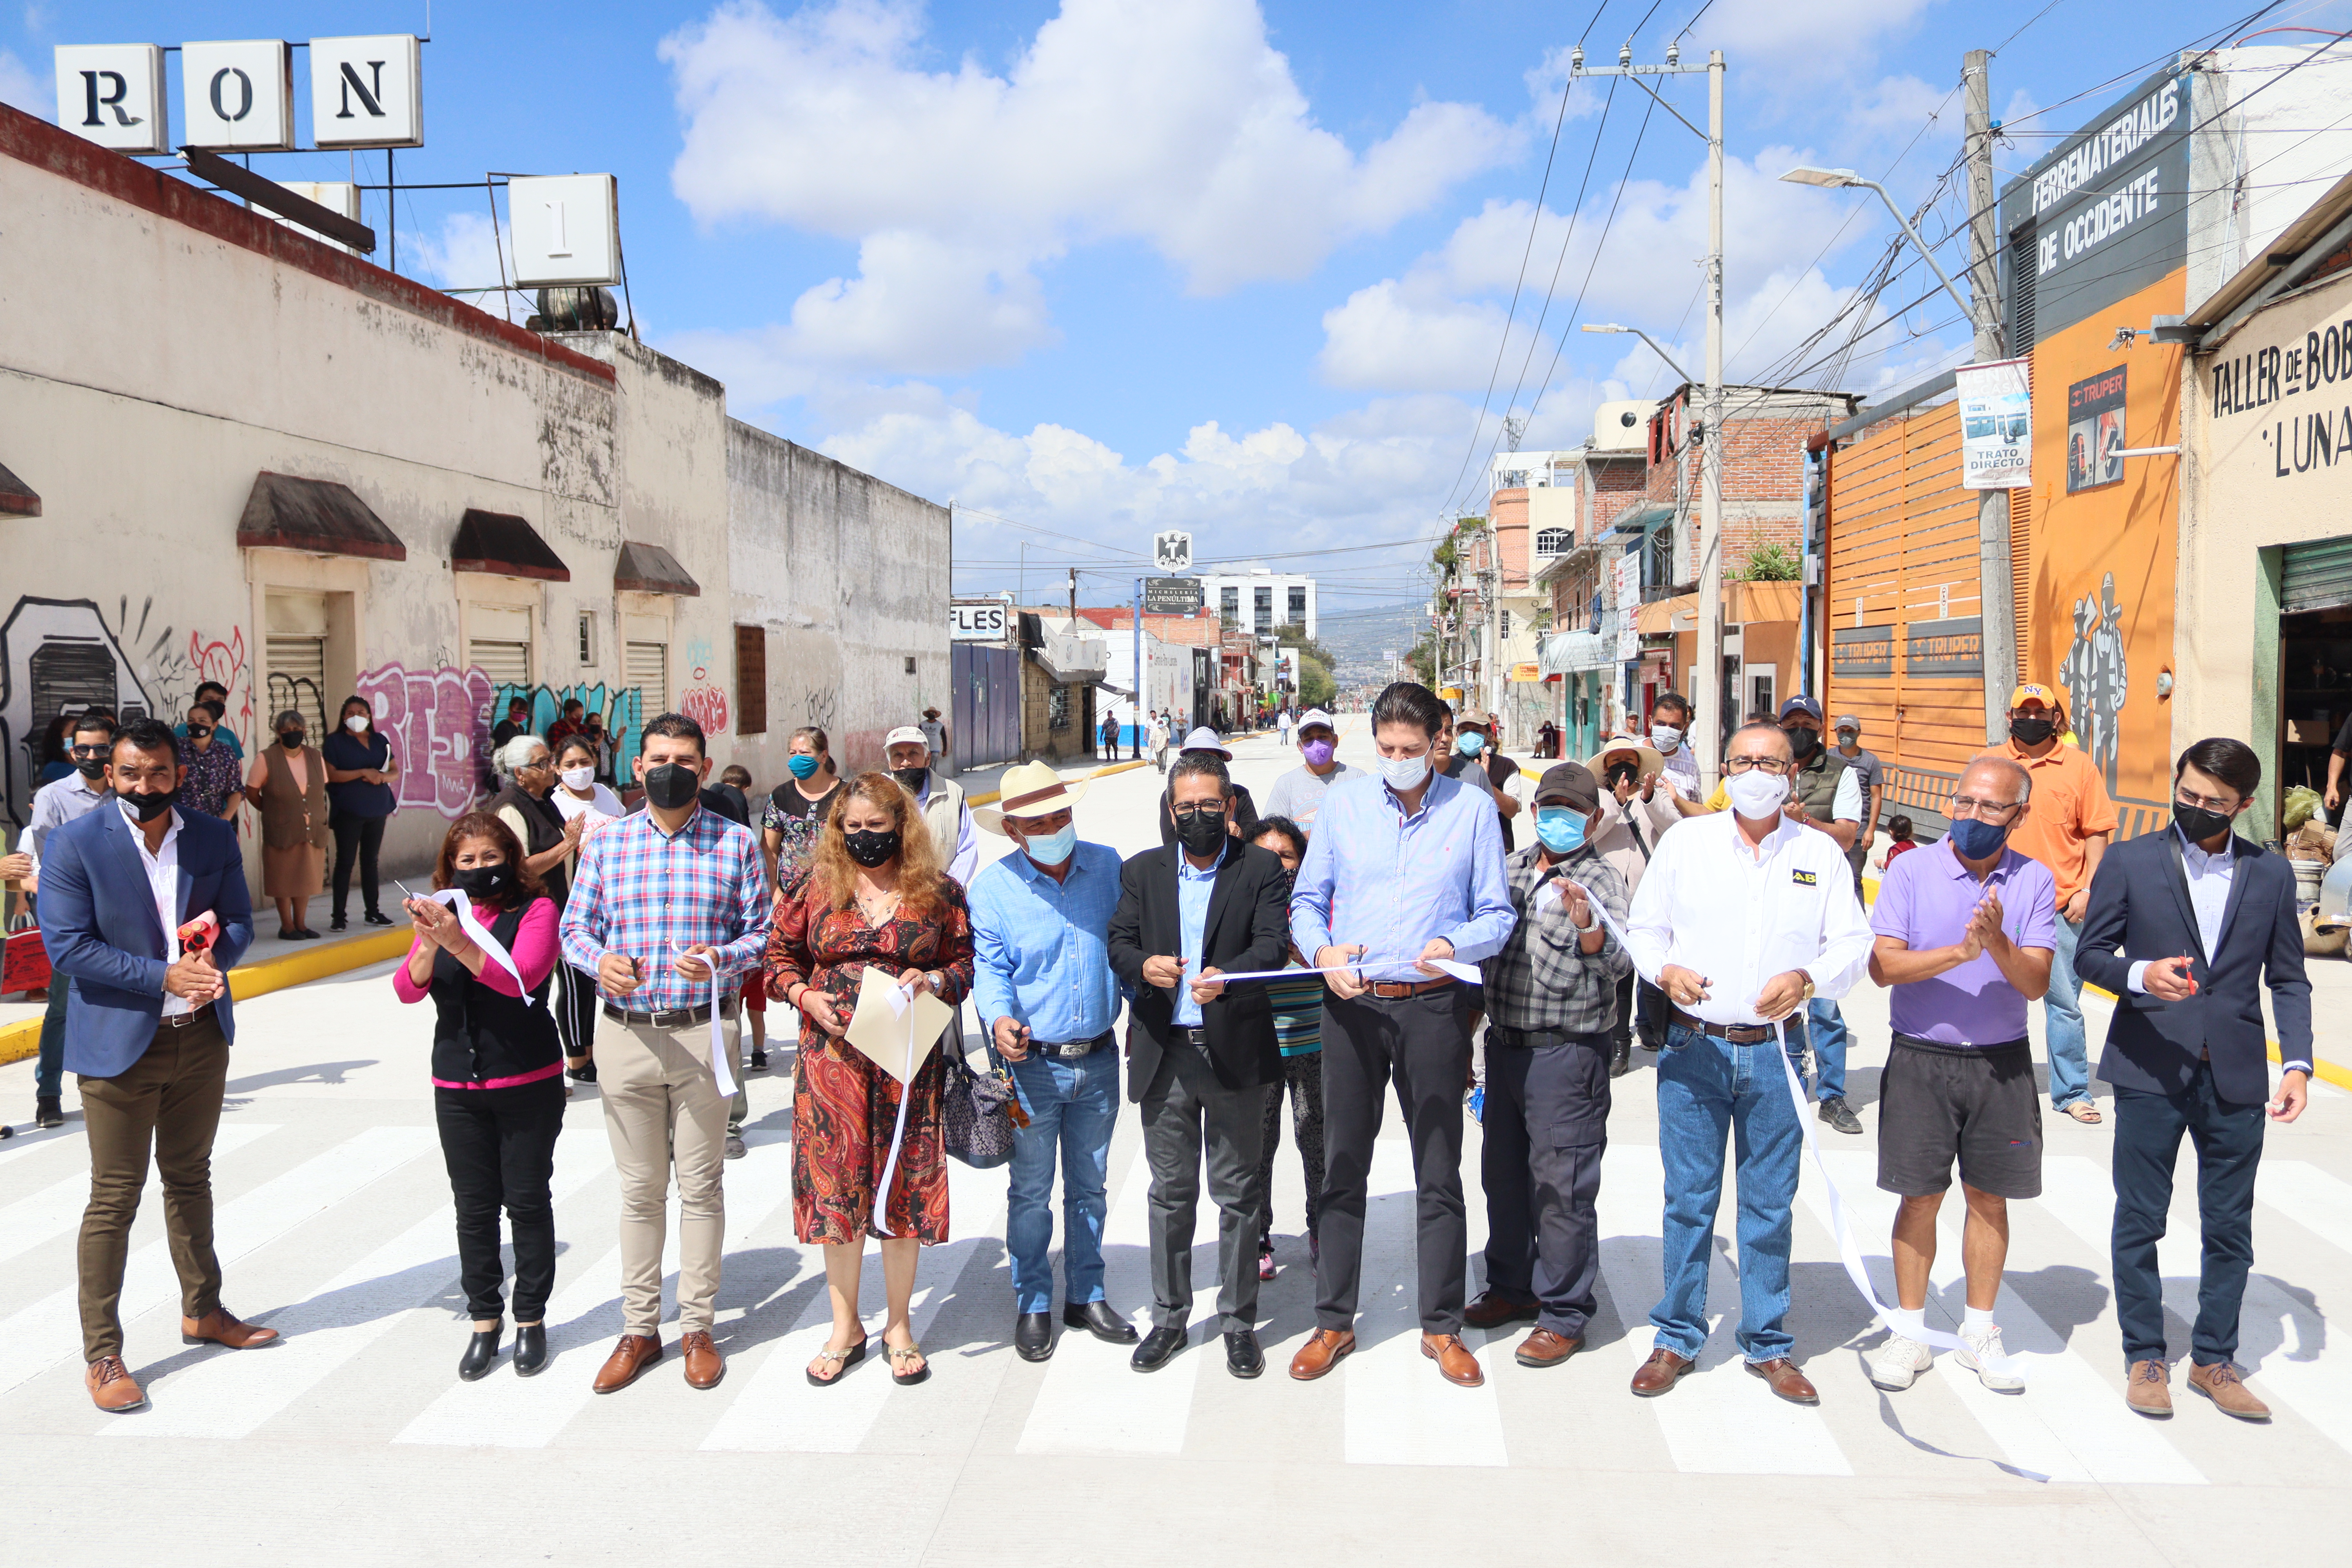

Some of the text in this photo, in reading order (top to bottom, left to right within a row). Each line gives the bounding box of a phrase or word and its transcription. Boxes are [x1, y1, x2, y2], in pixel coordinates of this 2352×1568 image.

[2032, 79, 2178, 216] FERREMATERIALES
[2039, 166, 2159, 276] DE OCCIDENTE
[1960, 365, 2027, 386] VENTA
[2212, 345, 2281, 419] TALLER
[2285, 348, 2301, 383] DE
[1965, 381, 2022, 397] de CASA
[2083, 374, 2123, 403] TRUPER
[1977, 449, 2018, 459] TRATO
[1971, 458, 2024, 469] DIRECTO
[1165, 542, 1179, 559] T
[1157, 594, 1198, 603] PENÚLTIMA
[1847, 642, 1887, 663] TRUPER
[1927, 635, 1979, 662] TRUPER
[2024, 686, 2042, 695] NY
[1773, 790, 1783, 799] AB
[122, 800, 133, 809] RC
[1793, 872, 1817, 883] AB
